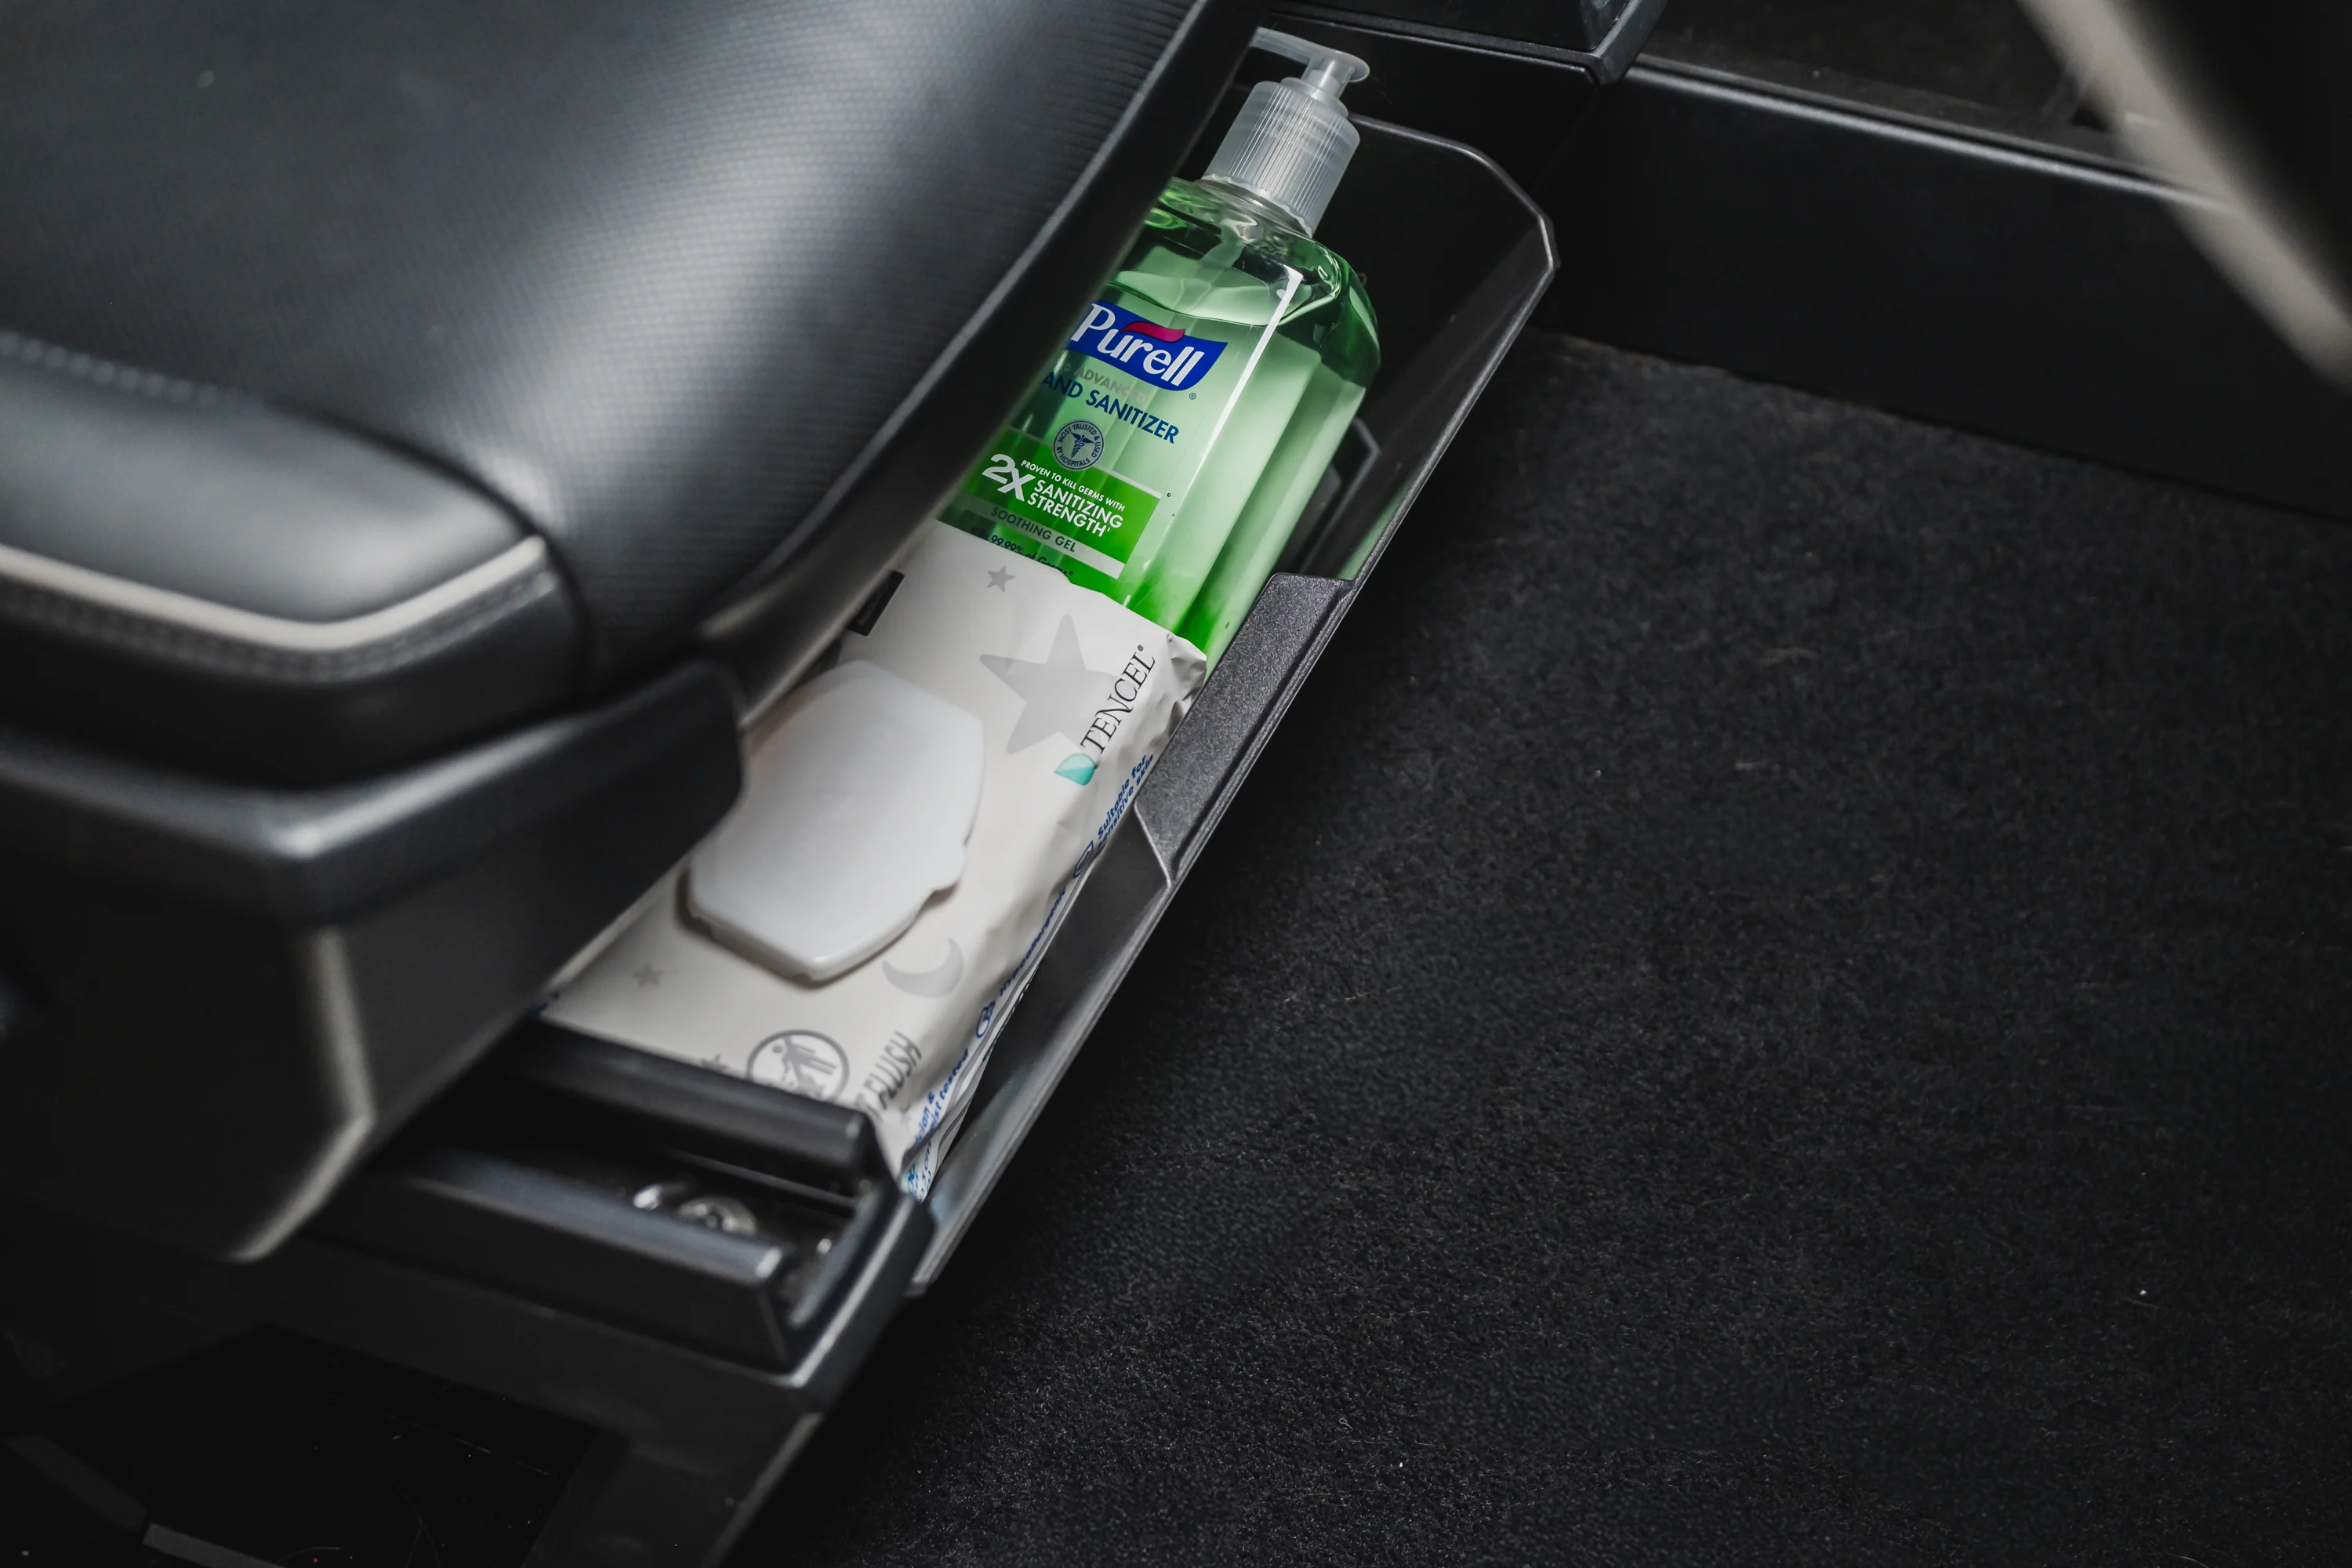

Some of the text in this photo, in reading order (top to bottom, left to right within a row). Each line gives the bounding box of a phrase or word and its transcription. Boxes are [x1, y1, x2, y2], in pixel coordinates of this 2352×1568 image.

[1070, 303, 1205, 387] Purell
[1042, 371, 1179, 444] AND SANITIZER
[1058, 426, 1071, 443] MOST
[1073, 423, 1097, 435] TRUSTED
[1091, 441, 1101, 458] USED
[1059, 453, 1091, 466] HOSPITALS
[982, 453, 1036, 502] 2X
[1021, 459, 1126, 512] PROVEN TO KILL GERMS WITH
[1034, 480, 1123, 528] SANITIZING
[991, 506, 1076, 553] SOOTHING GEL
[1136, 754, 1153, 786] skin
[1098, 754, 1146, 840] Suitable for
